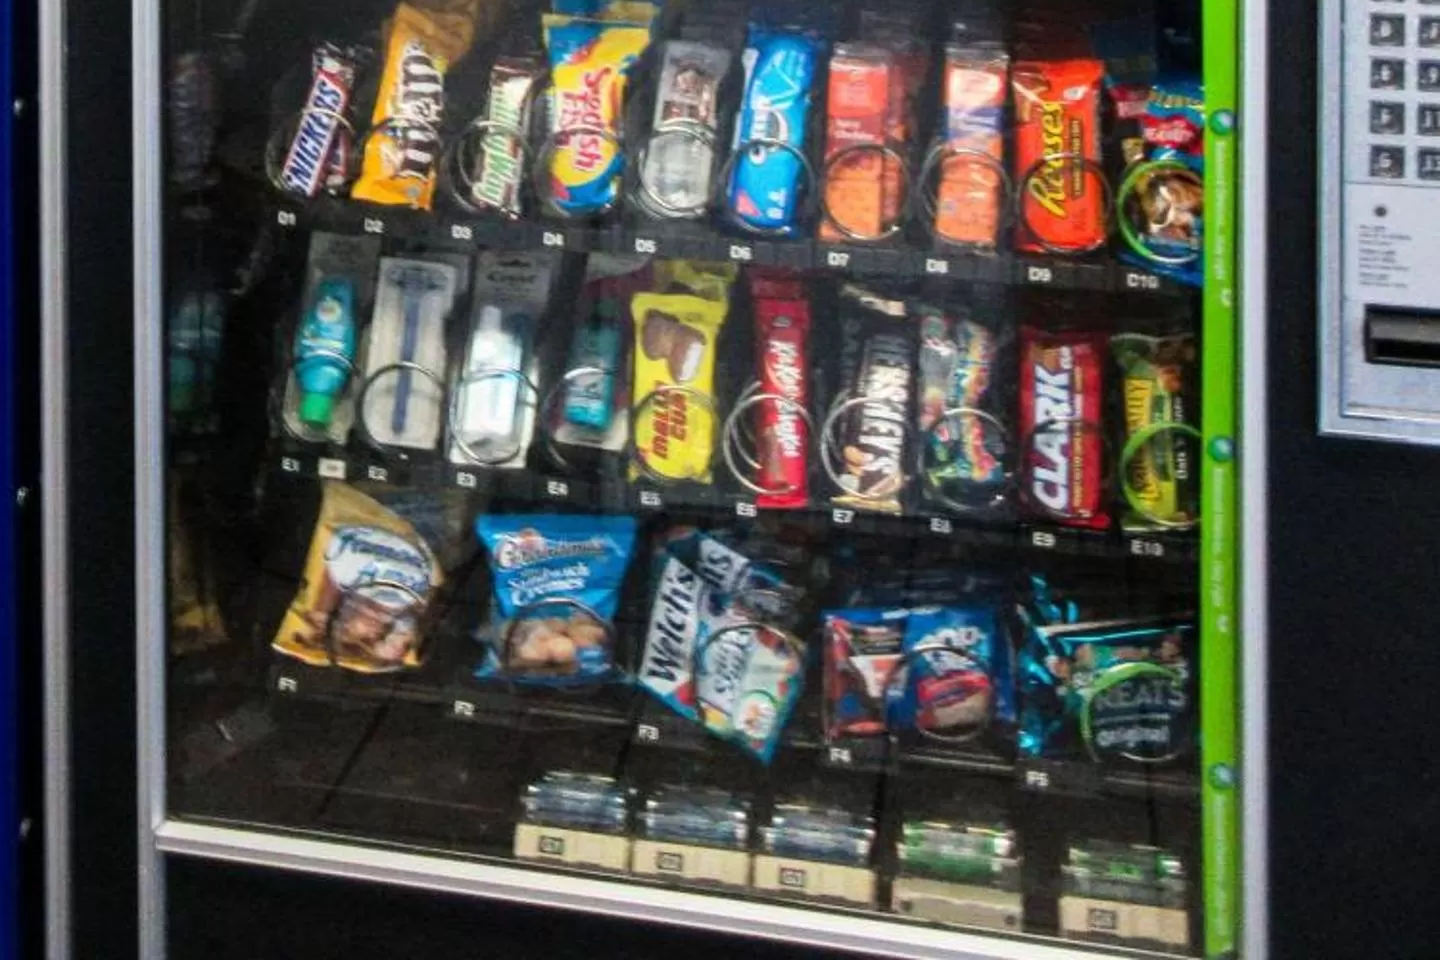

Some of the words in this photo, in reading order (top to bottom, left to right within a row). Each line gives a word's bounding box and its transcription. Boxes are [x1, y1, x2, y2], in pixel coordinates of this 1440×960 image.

[282, 79, 343, 197] SNICKERS
[1027, 102, 1068, 218] Reese's
[635, 239, 658, 254] D5
[729, 245, 752, 260] D6
[827, 252, 850, 266] D7
[1032, 365, 1072, 517] CLARK
[646, 565, 696, 683] Welch's
[454, 700, 476, 717] F2
